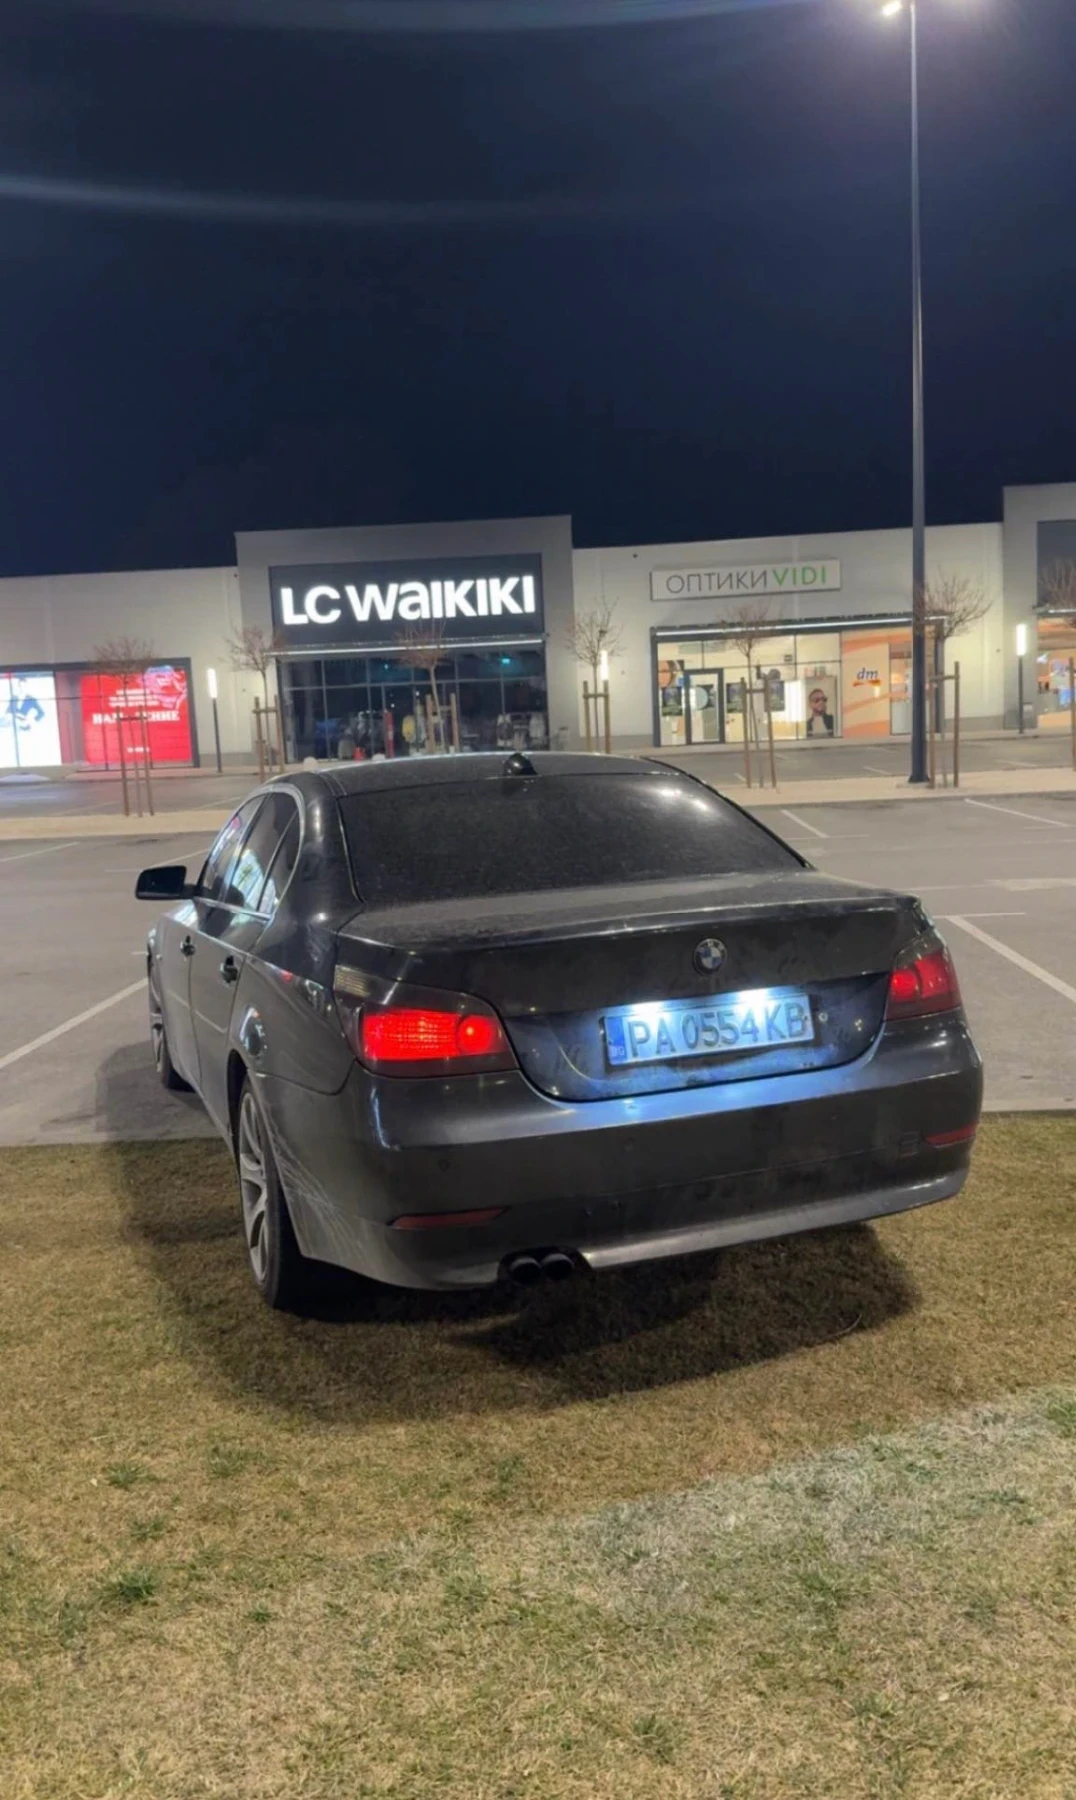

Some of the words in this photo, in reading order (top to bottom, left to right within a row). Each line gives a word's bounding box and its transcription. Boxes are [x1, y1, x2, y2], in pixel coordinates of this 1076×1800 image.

[666, 570, 767, 594] ОПТИКИ
[772, 565, 826, 587] VIDI
[280, 584, 341, 625] LC
[856, 667, 879, 680] dm
[628, 1016, 676, 1058] PA
[681, 1007, 760, 1050] 0554
